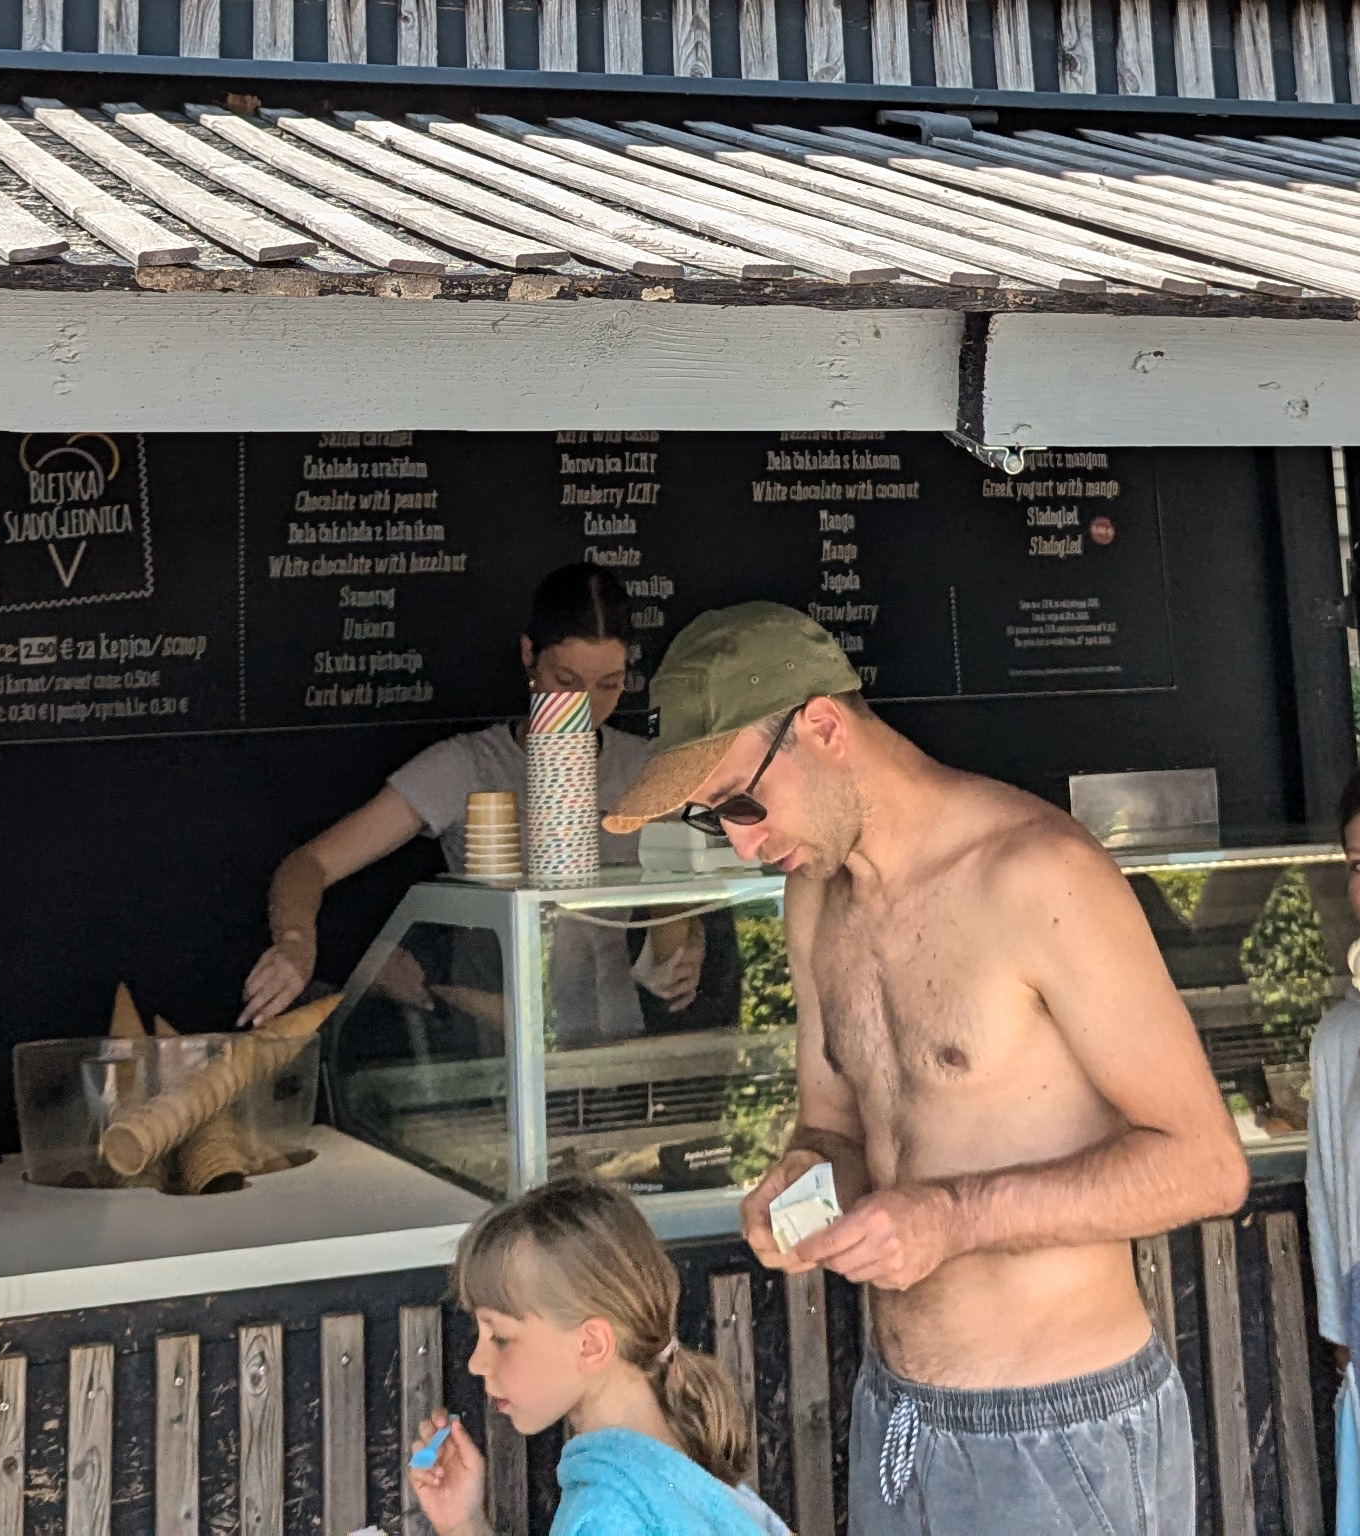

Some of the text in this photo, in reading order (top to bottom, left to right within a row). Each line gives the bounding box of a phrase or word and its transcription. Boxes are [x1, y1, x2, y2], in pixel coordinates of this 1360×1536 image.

[29, 470, 98, 506] BLEJSKA
[359, 488, 391, 511] with
[845, 478, 874, 500] with
[1016, 478, 1054, 502] yogurt
[1056, 477, 1083, 498] with
[1085, 479, 1120, 500] mango
[4, 504, 133, 544] SLADOGLEDNICA
[374, 551, 407, 574] with
